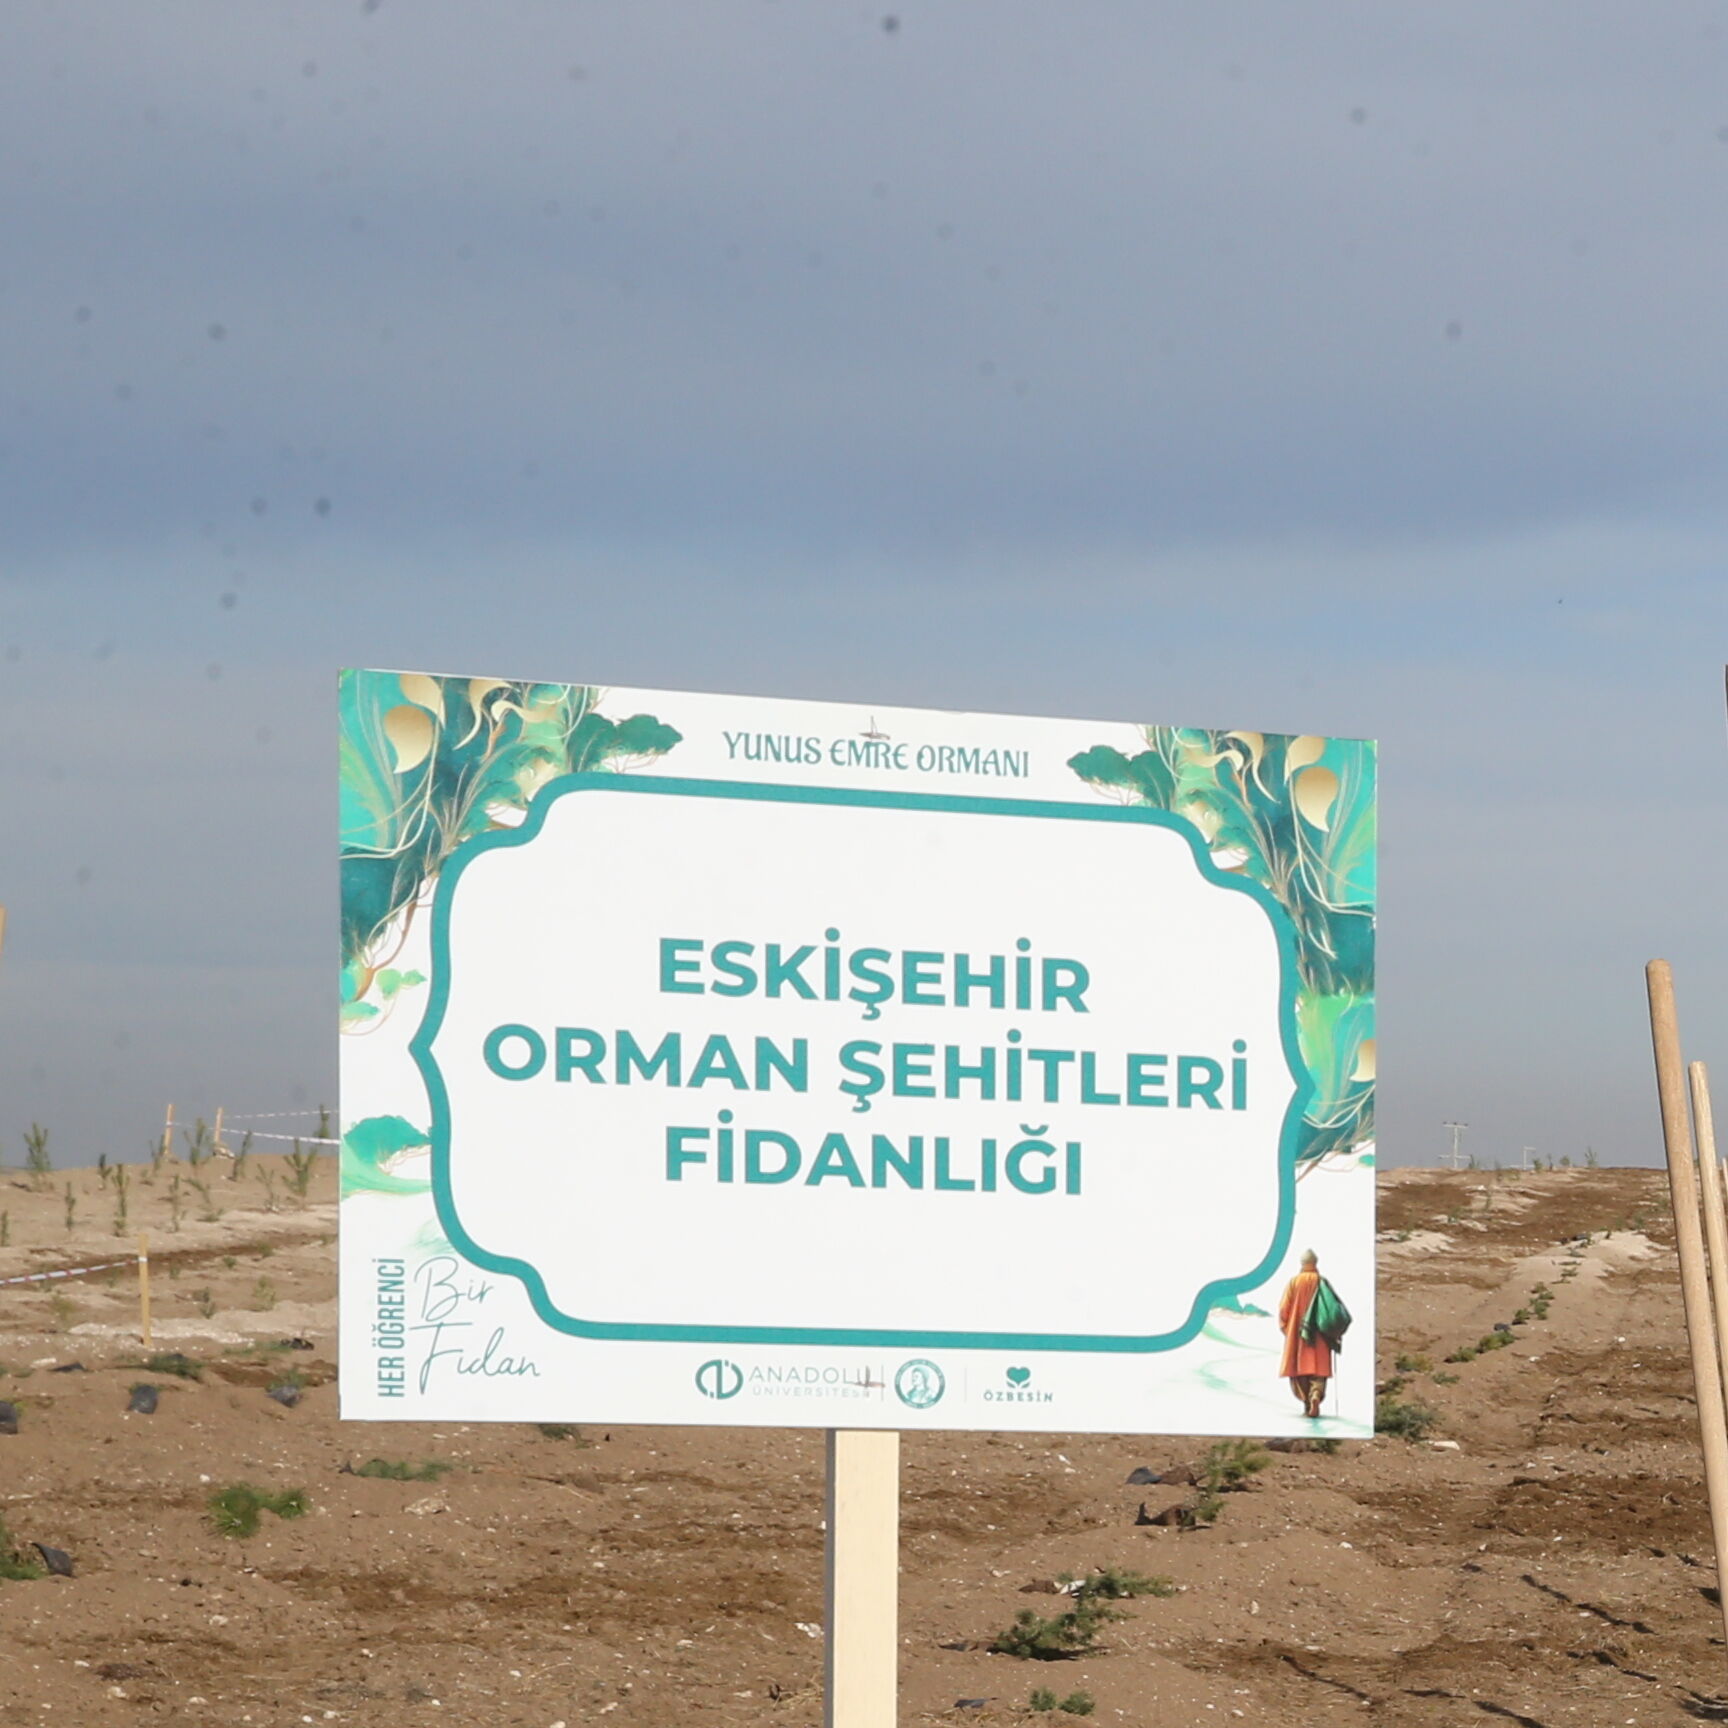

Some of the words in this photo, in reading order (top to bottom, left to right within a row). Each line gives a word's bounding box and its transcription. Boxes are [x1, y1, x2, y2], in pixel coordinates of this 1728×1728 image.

[724, 732, 824, 765] YUNUS
[829, 739, 908, 771] EMRE
[915, 746, 1030, 777] ORMANI
[658, 927, 1091, 1020] ESKİŞEHİR
[481, 1023, 809, 1093] ORMAN
[837, 1028, 1248, 1113] ŞEHİTLERİ
[664, 1109, 1083, 1195] FİDANLIĞI
[371, 1258, 405, 1350] ÖĞRENCİ
[414, 1256, 494, 1322] Bir
[377, 1356, 405, 1397] HER
[409, 1322, 541, 1395] Fidan
